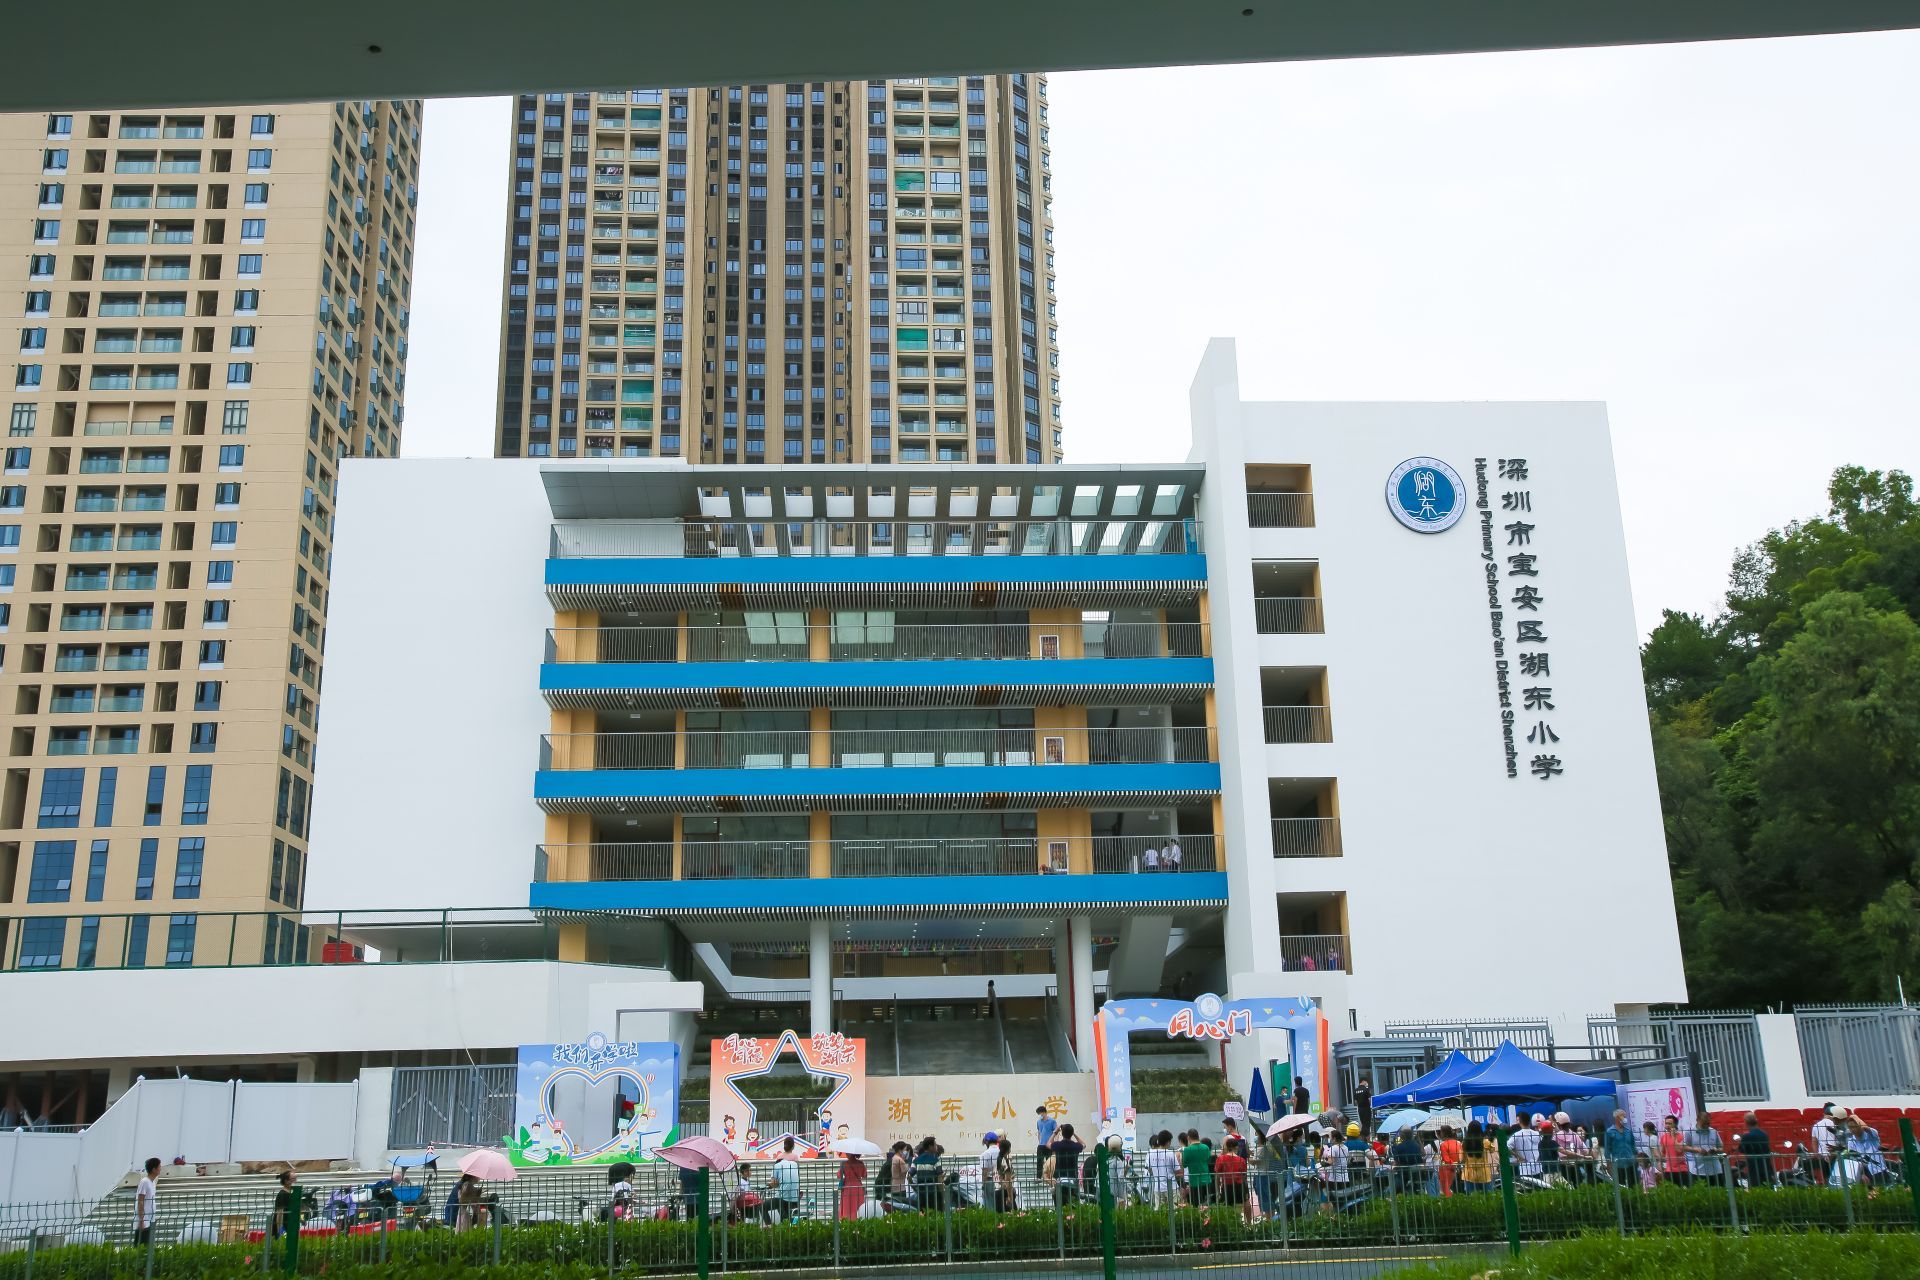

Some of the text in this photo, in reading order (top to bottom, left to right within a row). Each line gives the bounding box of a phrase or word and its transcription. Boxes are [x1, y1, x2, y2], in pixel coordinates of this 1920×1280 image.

[1475, 458, 1518, 778] Hudong Primary School Bao'an District Shenzhen
[1498, 458, 1563, 780] 深圳市宝安区湖东小学
[1168, 1008, 1252, 1039] 同心门
[553, 1042, 638, 1071] 我们开学啦
[888, 1096, 1068, 1123] 湖东小学
